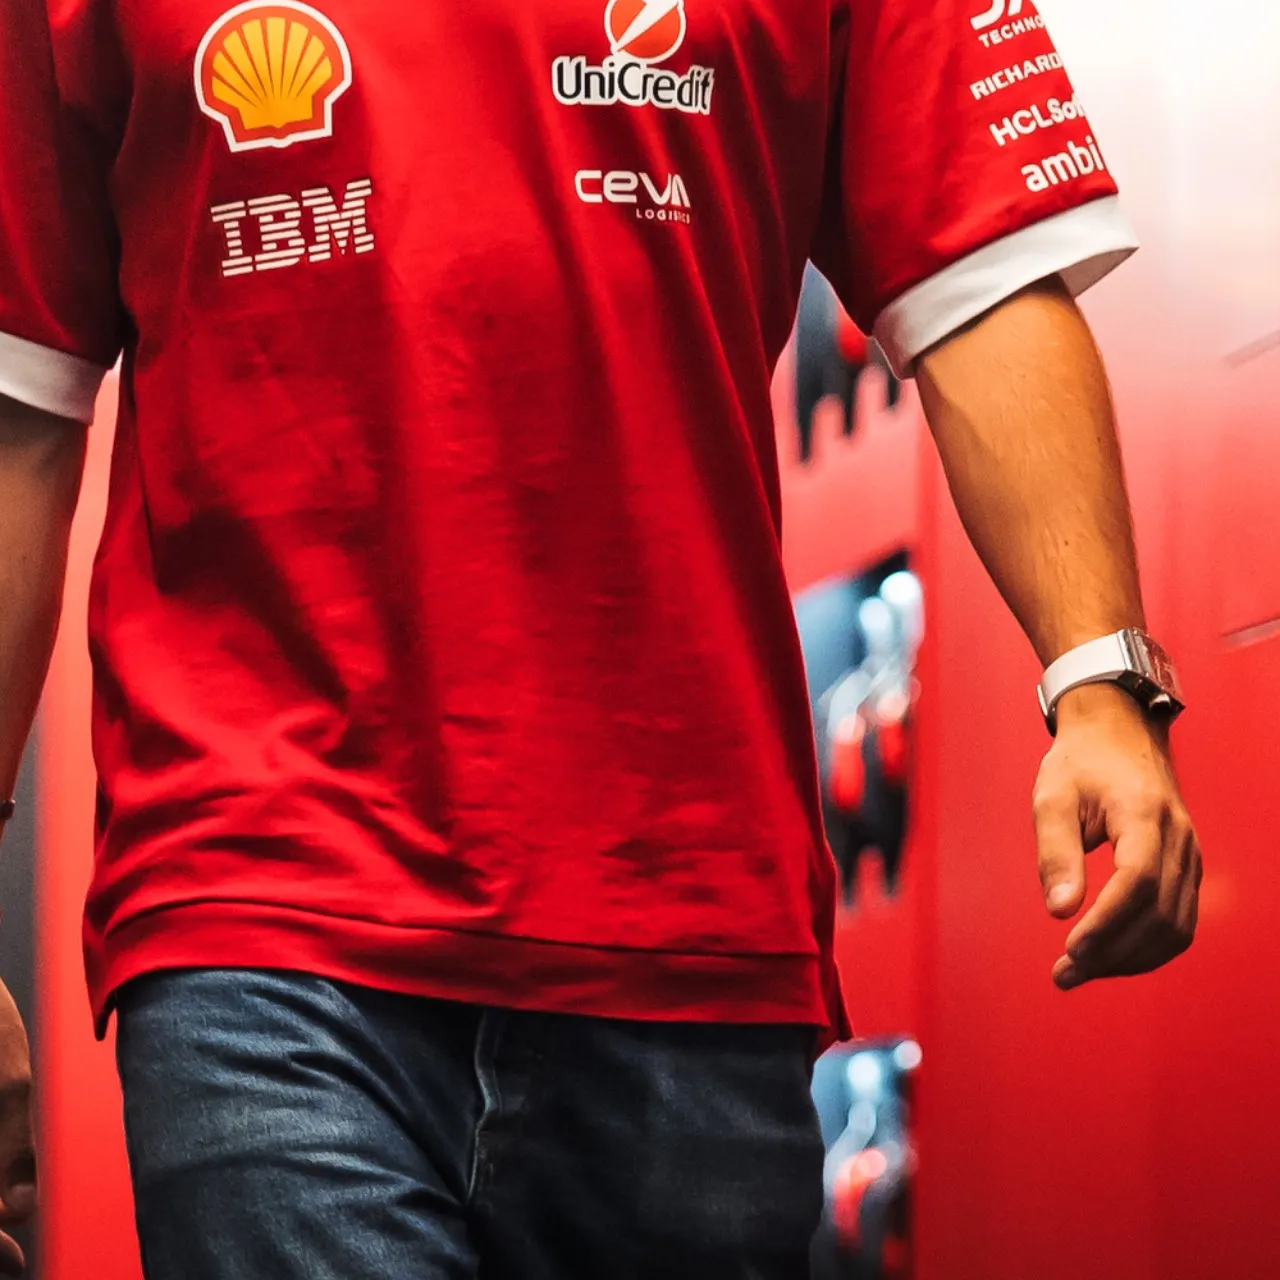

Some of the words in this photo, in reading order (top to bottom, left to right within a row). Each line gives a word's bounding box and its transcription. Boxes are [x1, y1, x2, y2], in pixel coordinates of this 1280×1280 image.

[556, 60, 711, 111] UniCredit
[1021, 135, 1106, 193] ambi
[210, 178, 376, 278] IBM
